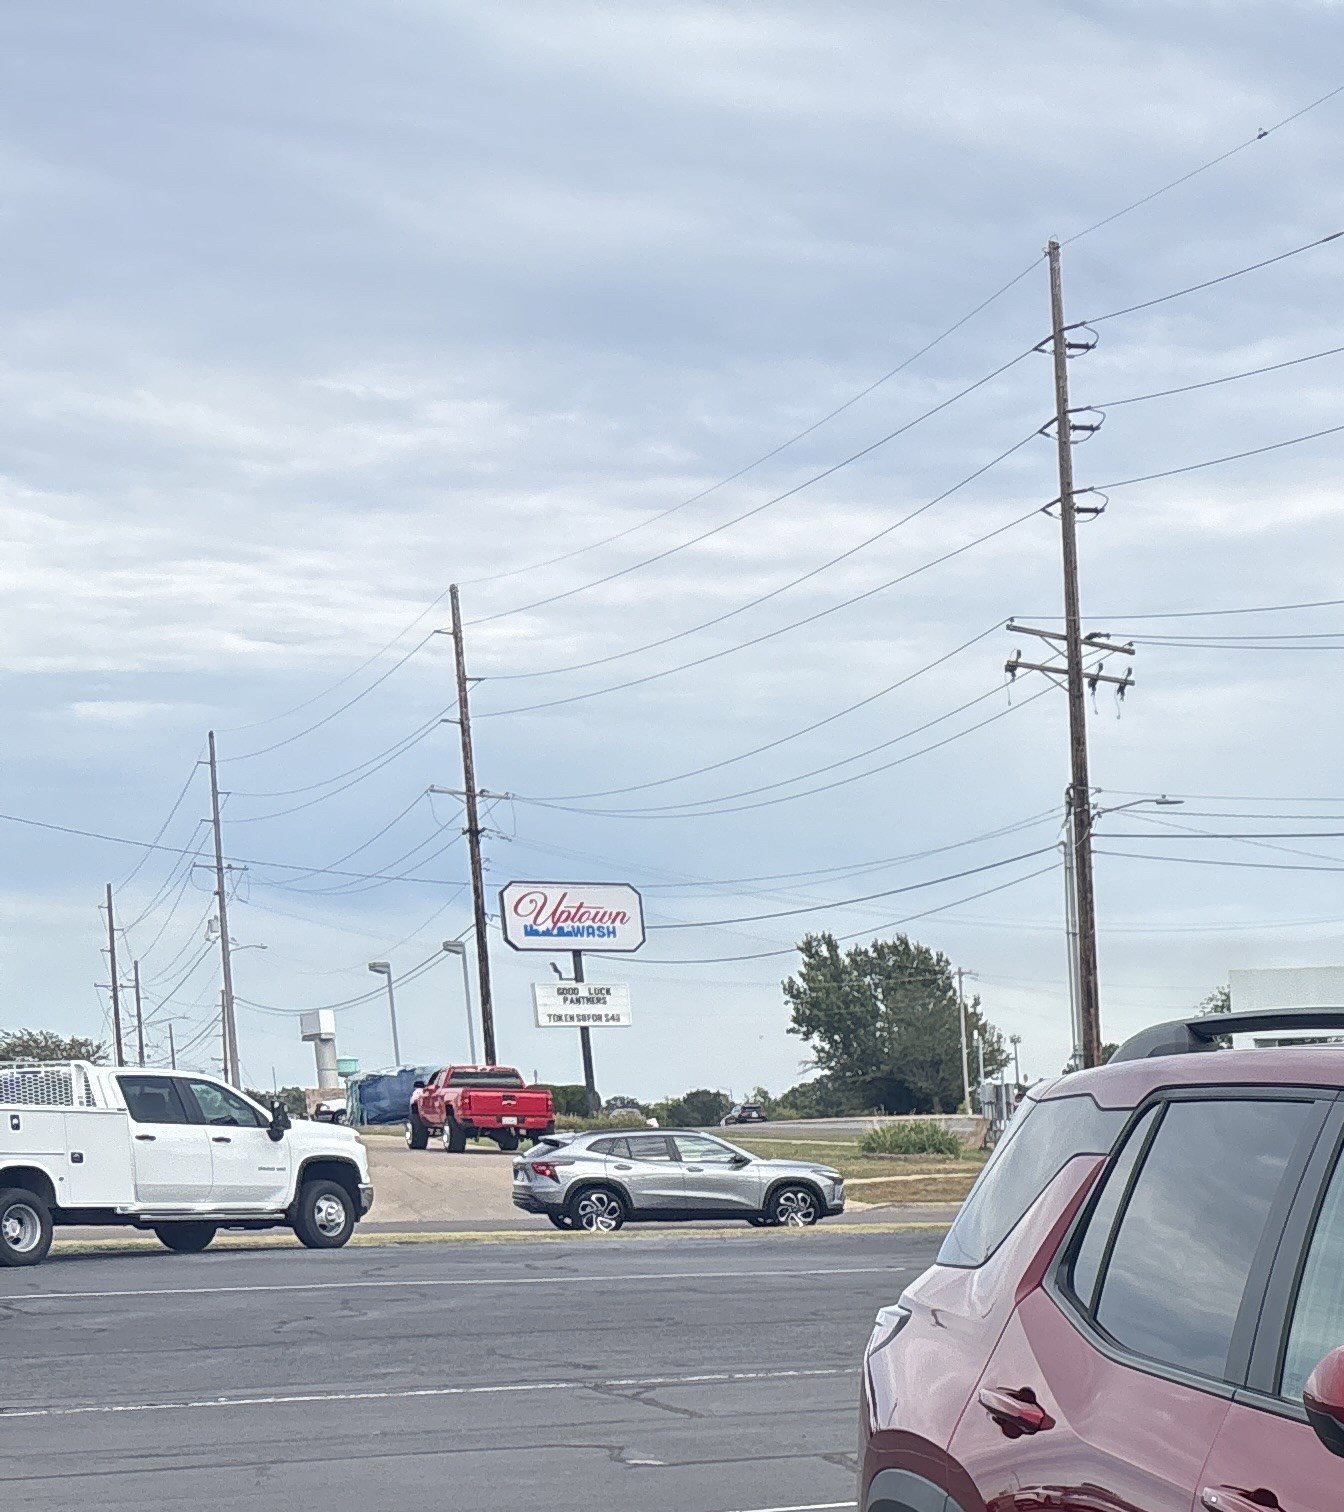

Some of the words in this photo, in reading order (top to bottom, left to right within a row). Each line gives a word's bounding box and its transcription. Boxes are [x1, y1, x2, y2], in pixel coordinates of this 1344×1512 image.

[513, 890, 631, 932] Uptown
[571, 925, 617, 938] WASH
[557, 987, 580, 996] GOOD
[588, 987, 612, 996] LUCK
[563, 996, 608, 1005] PANTHERS
